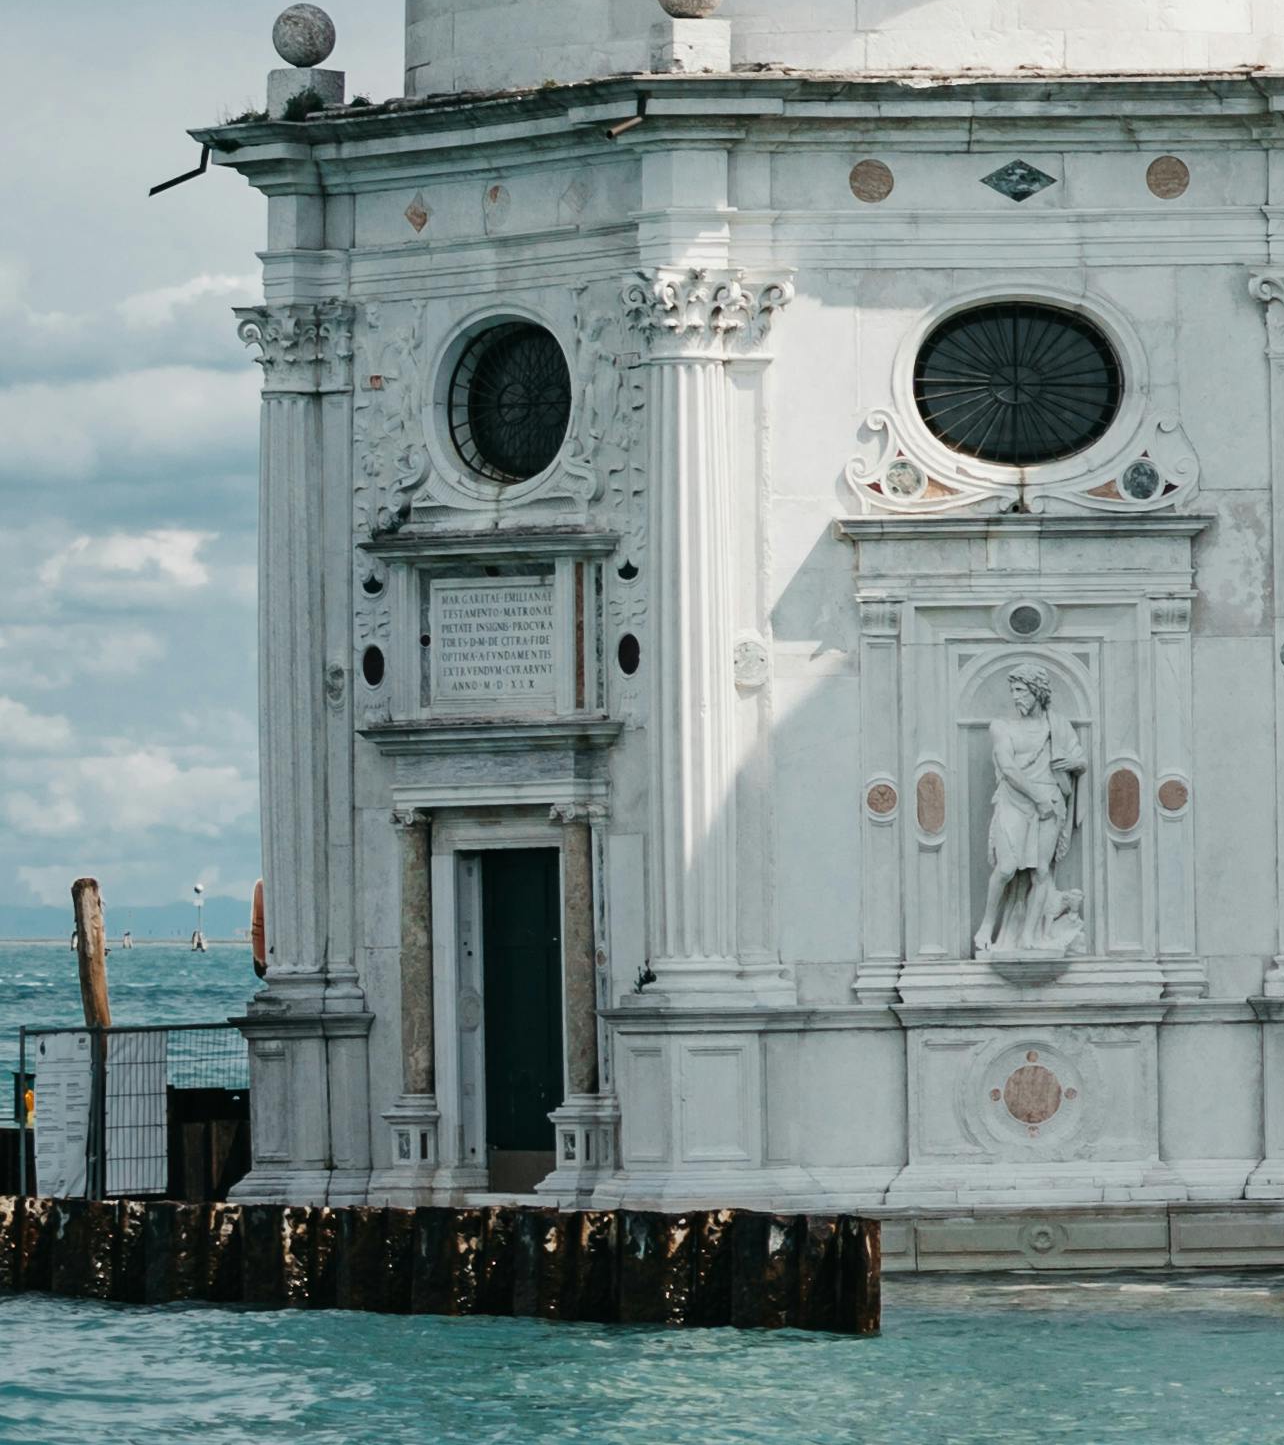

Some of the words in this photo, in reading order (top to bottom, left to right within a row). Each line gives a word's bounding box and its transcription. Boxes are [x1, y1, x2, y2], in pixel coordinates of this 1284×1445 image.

[442, 607, 499, 619] TESTAMENTO
[503, 606, 554, 618] MATRONAE
[451, 680, 478, 691] ANNO
